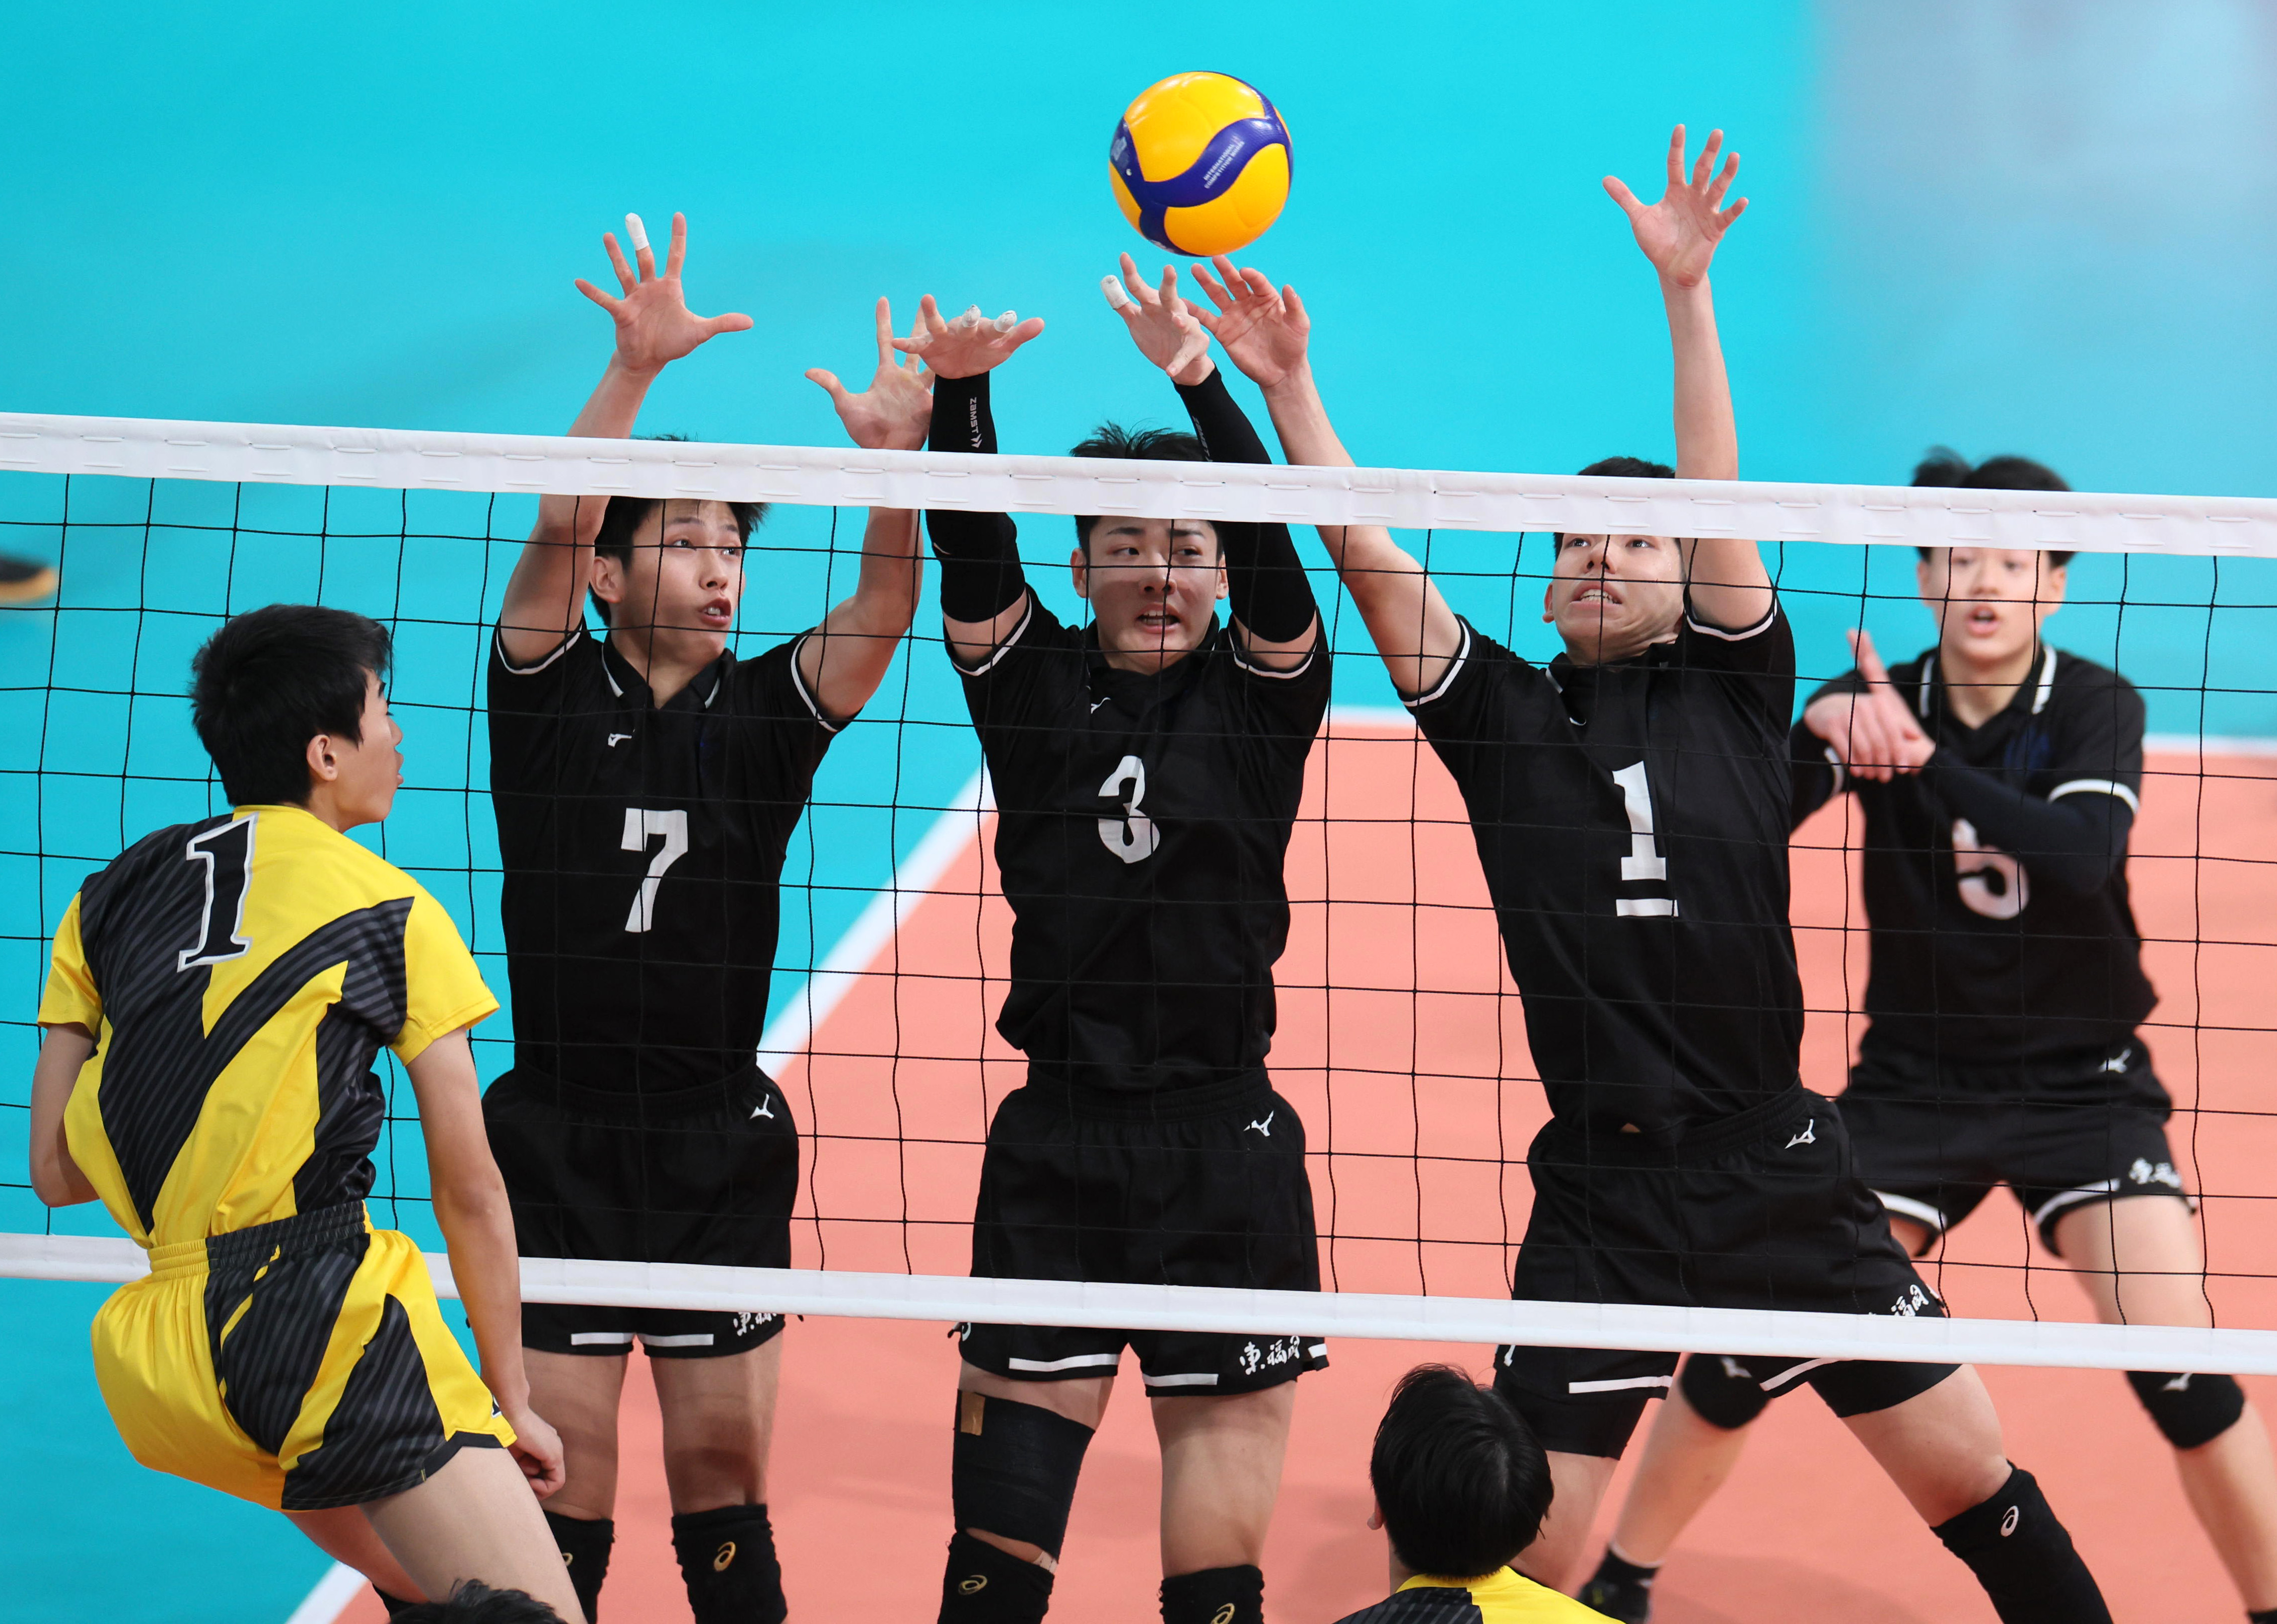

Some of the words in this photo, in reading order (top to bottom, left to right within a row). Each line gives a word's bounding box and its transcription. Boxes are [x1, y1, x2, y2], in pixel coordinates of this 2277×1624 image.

[621, 808, 688, 933] 7
[1098, 755, 1160, 864] 3
[1612, 760, 1666, 881] 1
[177, 811, 259, 972] 1
